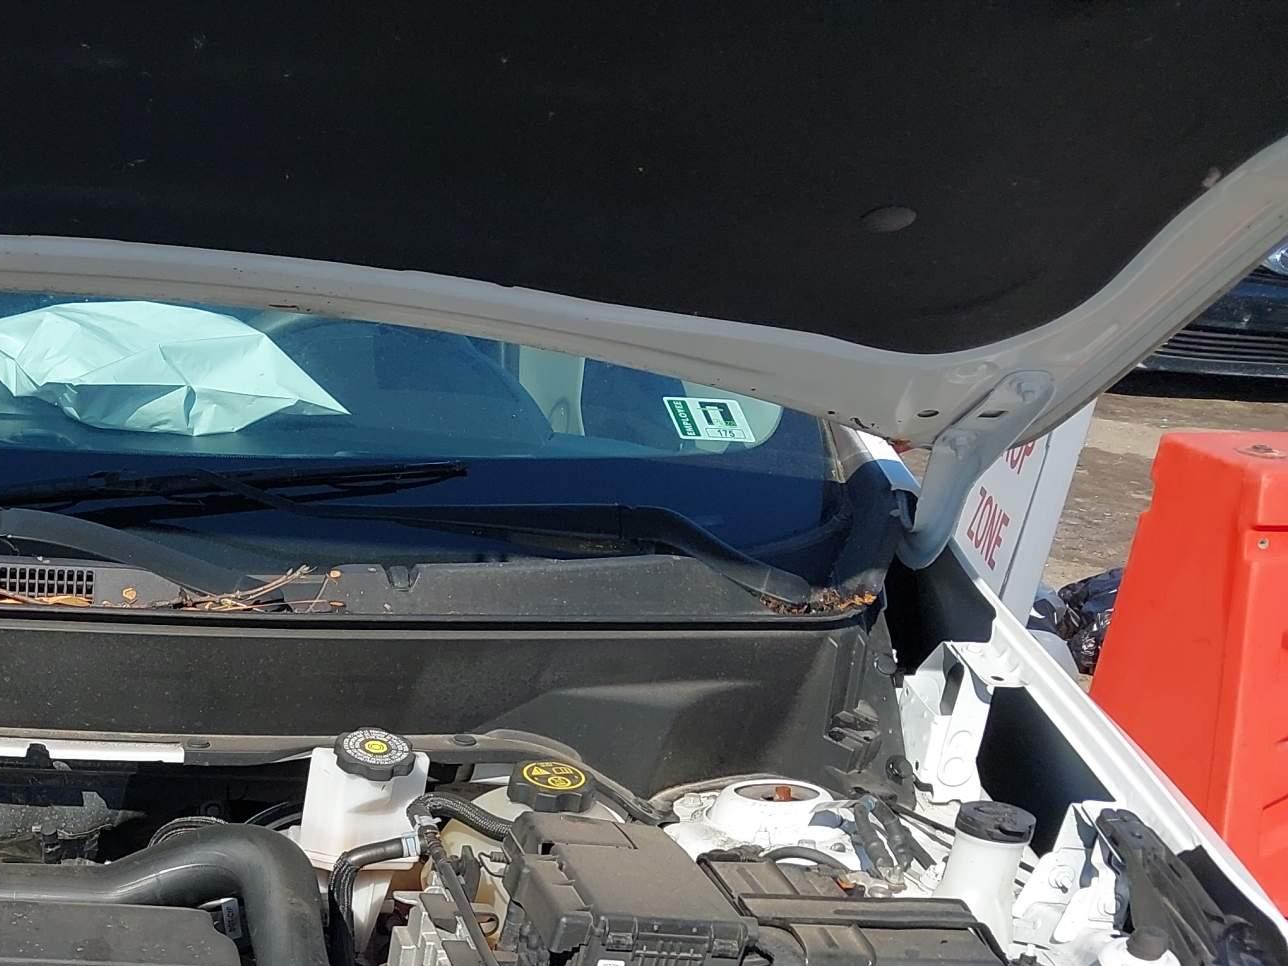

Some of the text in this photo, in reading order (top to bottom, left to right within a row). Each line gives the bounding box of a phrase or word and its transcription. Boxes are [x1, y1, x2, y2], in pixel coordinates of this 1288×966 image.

[672, 401, 696, 436] EMPLOYEE
[717, 429, 735, 438] 175
[967, 486, 1010, 571] ZONE
